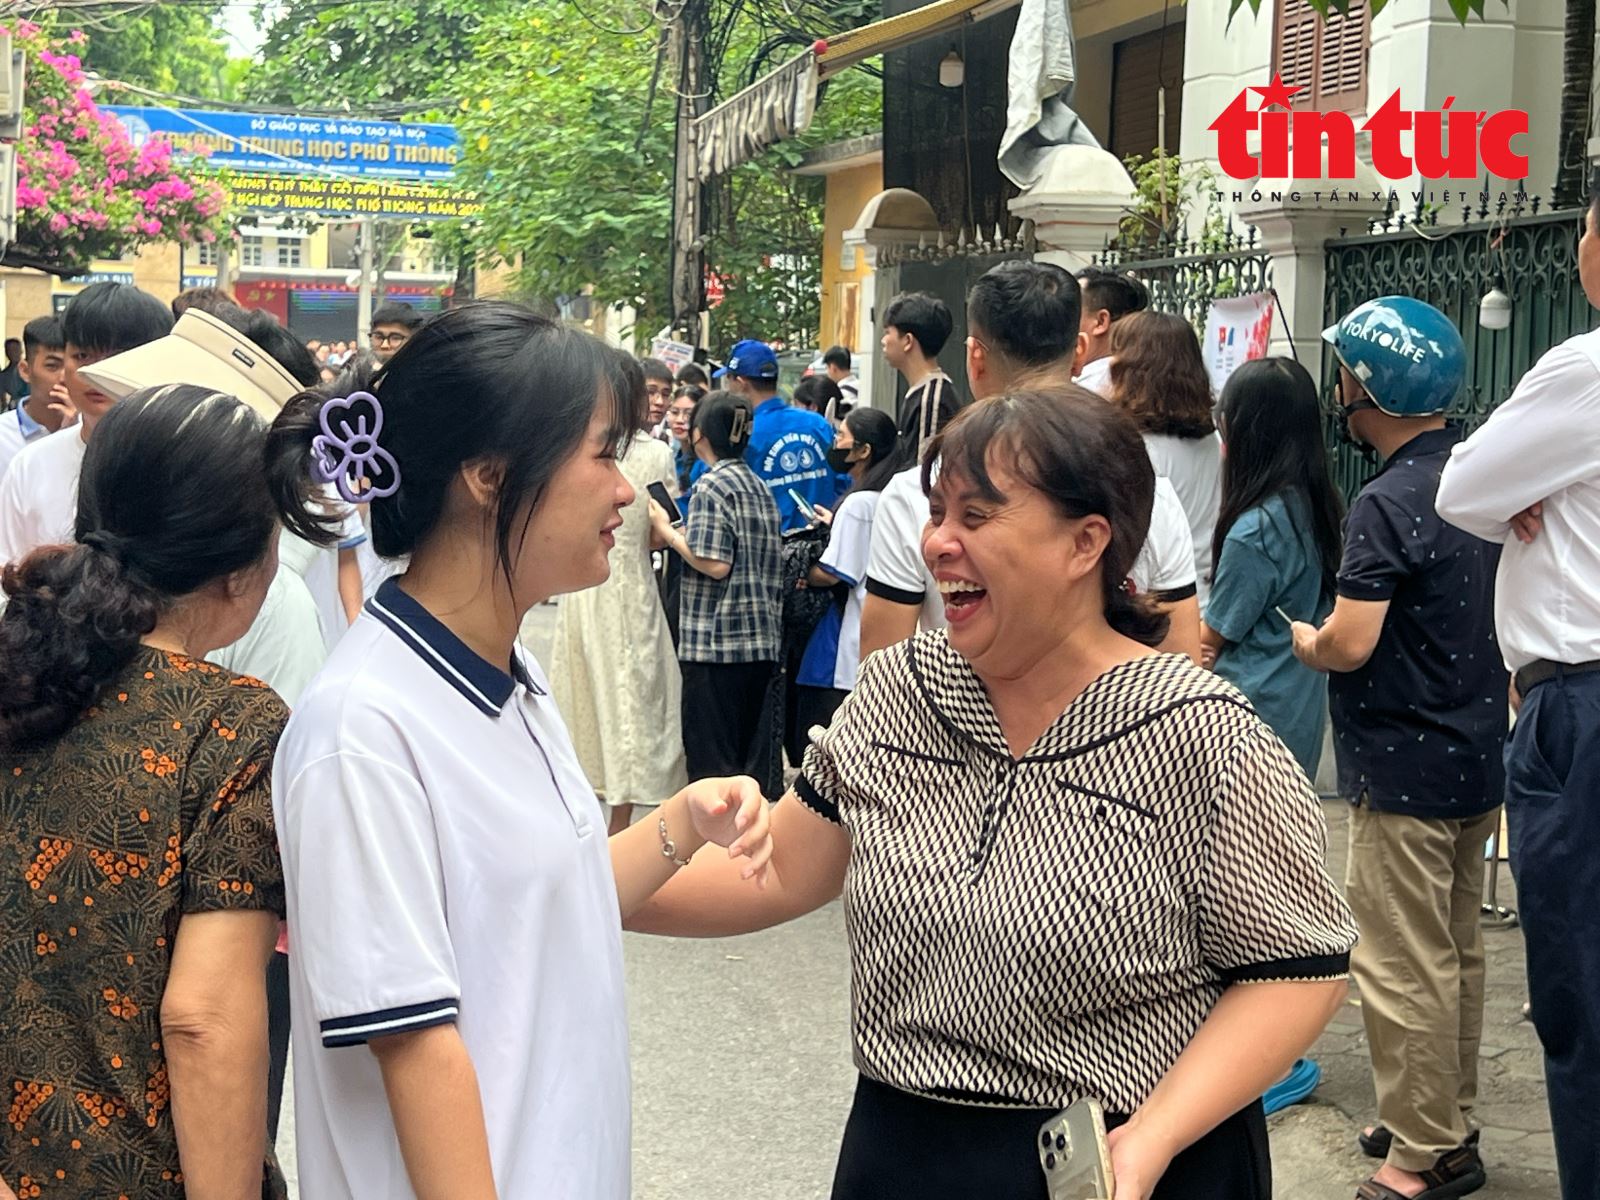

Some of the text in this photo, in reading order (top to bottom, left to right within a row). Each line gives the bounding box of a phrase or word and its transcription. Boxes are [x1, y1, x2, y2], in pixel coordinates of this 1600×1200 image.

[268, 116, 297, 131] GIÁO
[299, 122, 321, 136] DỤC
[324, 121, 338, 134] VÀ
[340, 123, 363, 135] ĐÀO
[365, 126, 387, 140] TẠO
[388, 125, 403, 138] HÀ
[406, 128, 427, 141] NỘI
[239, 136, 305, 157] TRUNG
[307, 140, 347, 162] HỌC
[350, 139, 390, 161] PHỔ
[393, 143, 458, 165] THÔNG
[284, 194, 325, 209] TRUNG
[458, 203, 485, 216] 202
